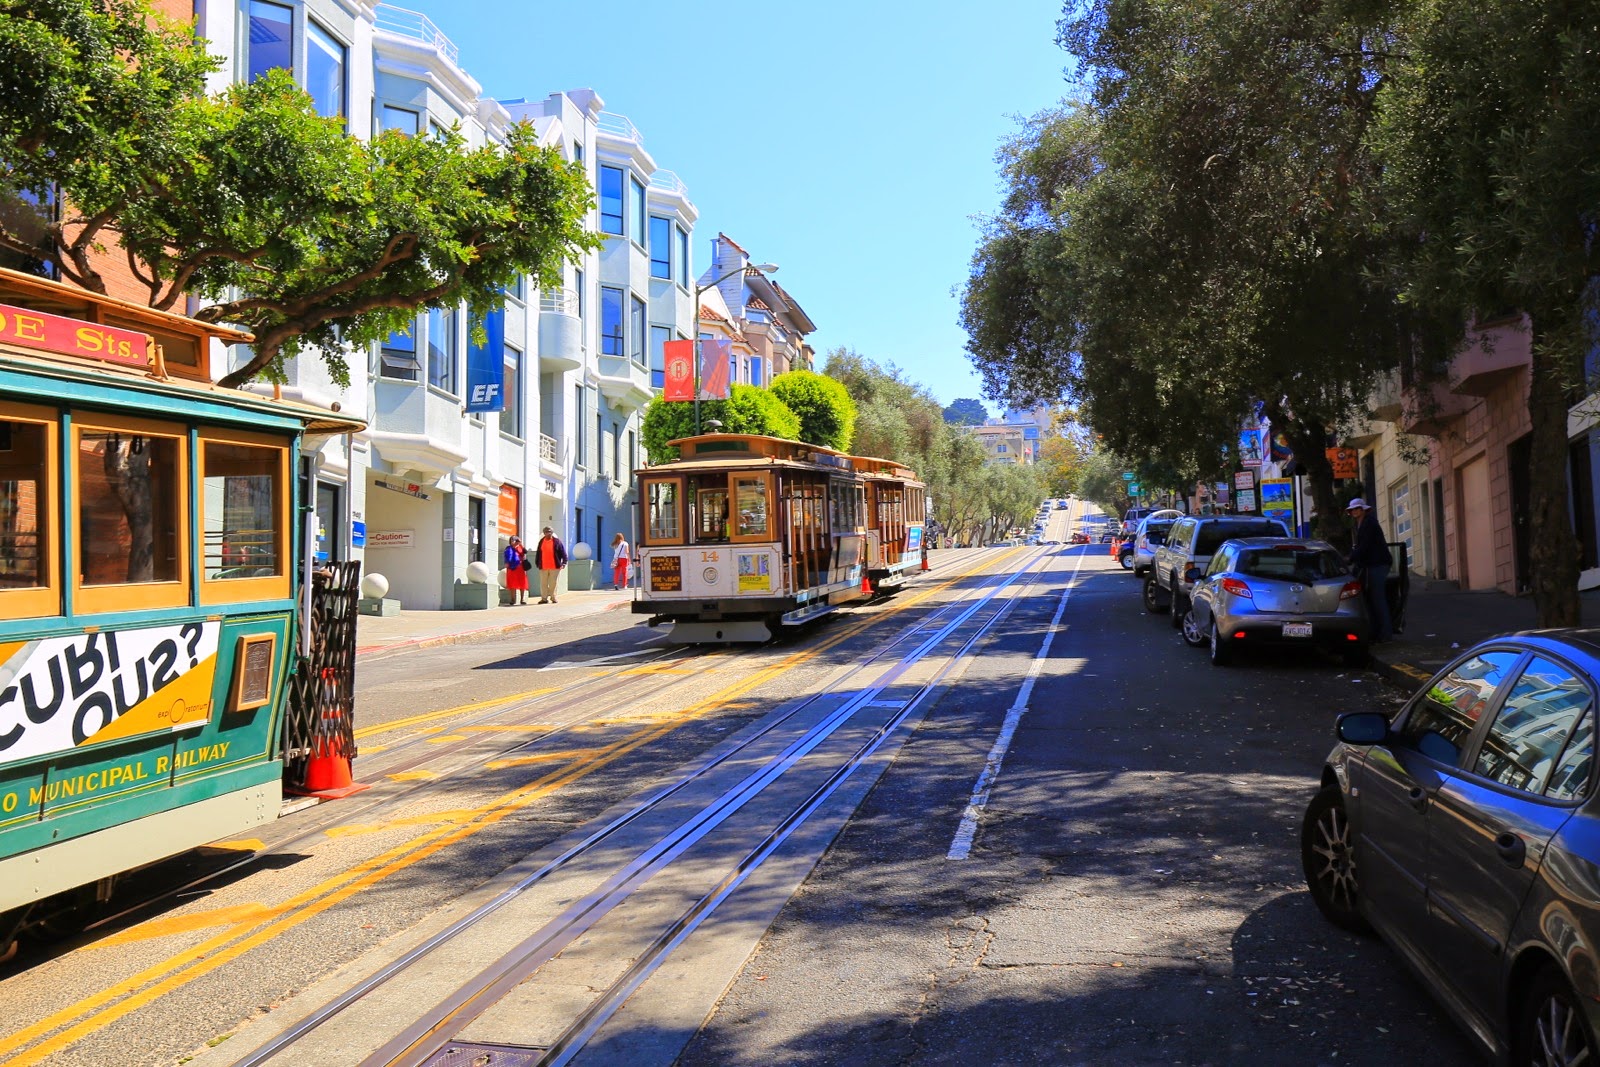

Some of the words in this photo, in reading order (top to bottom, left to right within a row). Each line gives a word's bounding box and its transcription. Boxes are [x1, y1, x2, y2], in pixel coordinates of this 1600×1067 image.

[0, 311, 45, 341] E
[76, 327, 139, 359] Sts.
[471, 383, 499, 402] EF
[701, 551, 719, 562] 14
[28, 762, 148, 806] MUNICIPAL
[156, 742, 231, 775] RAILWAY
